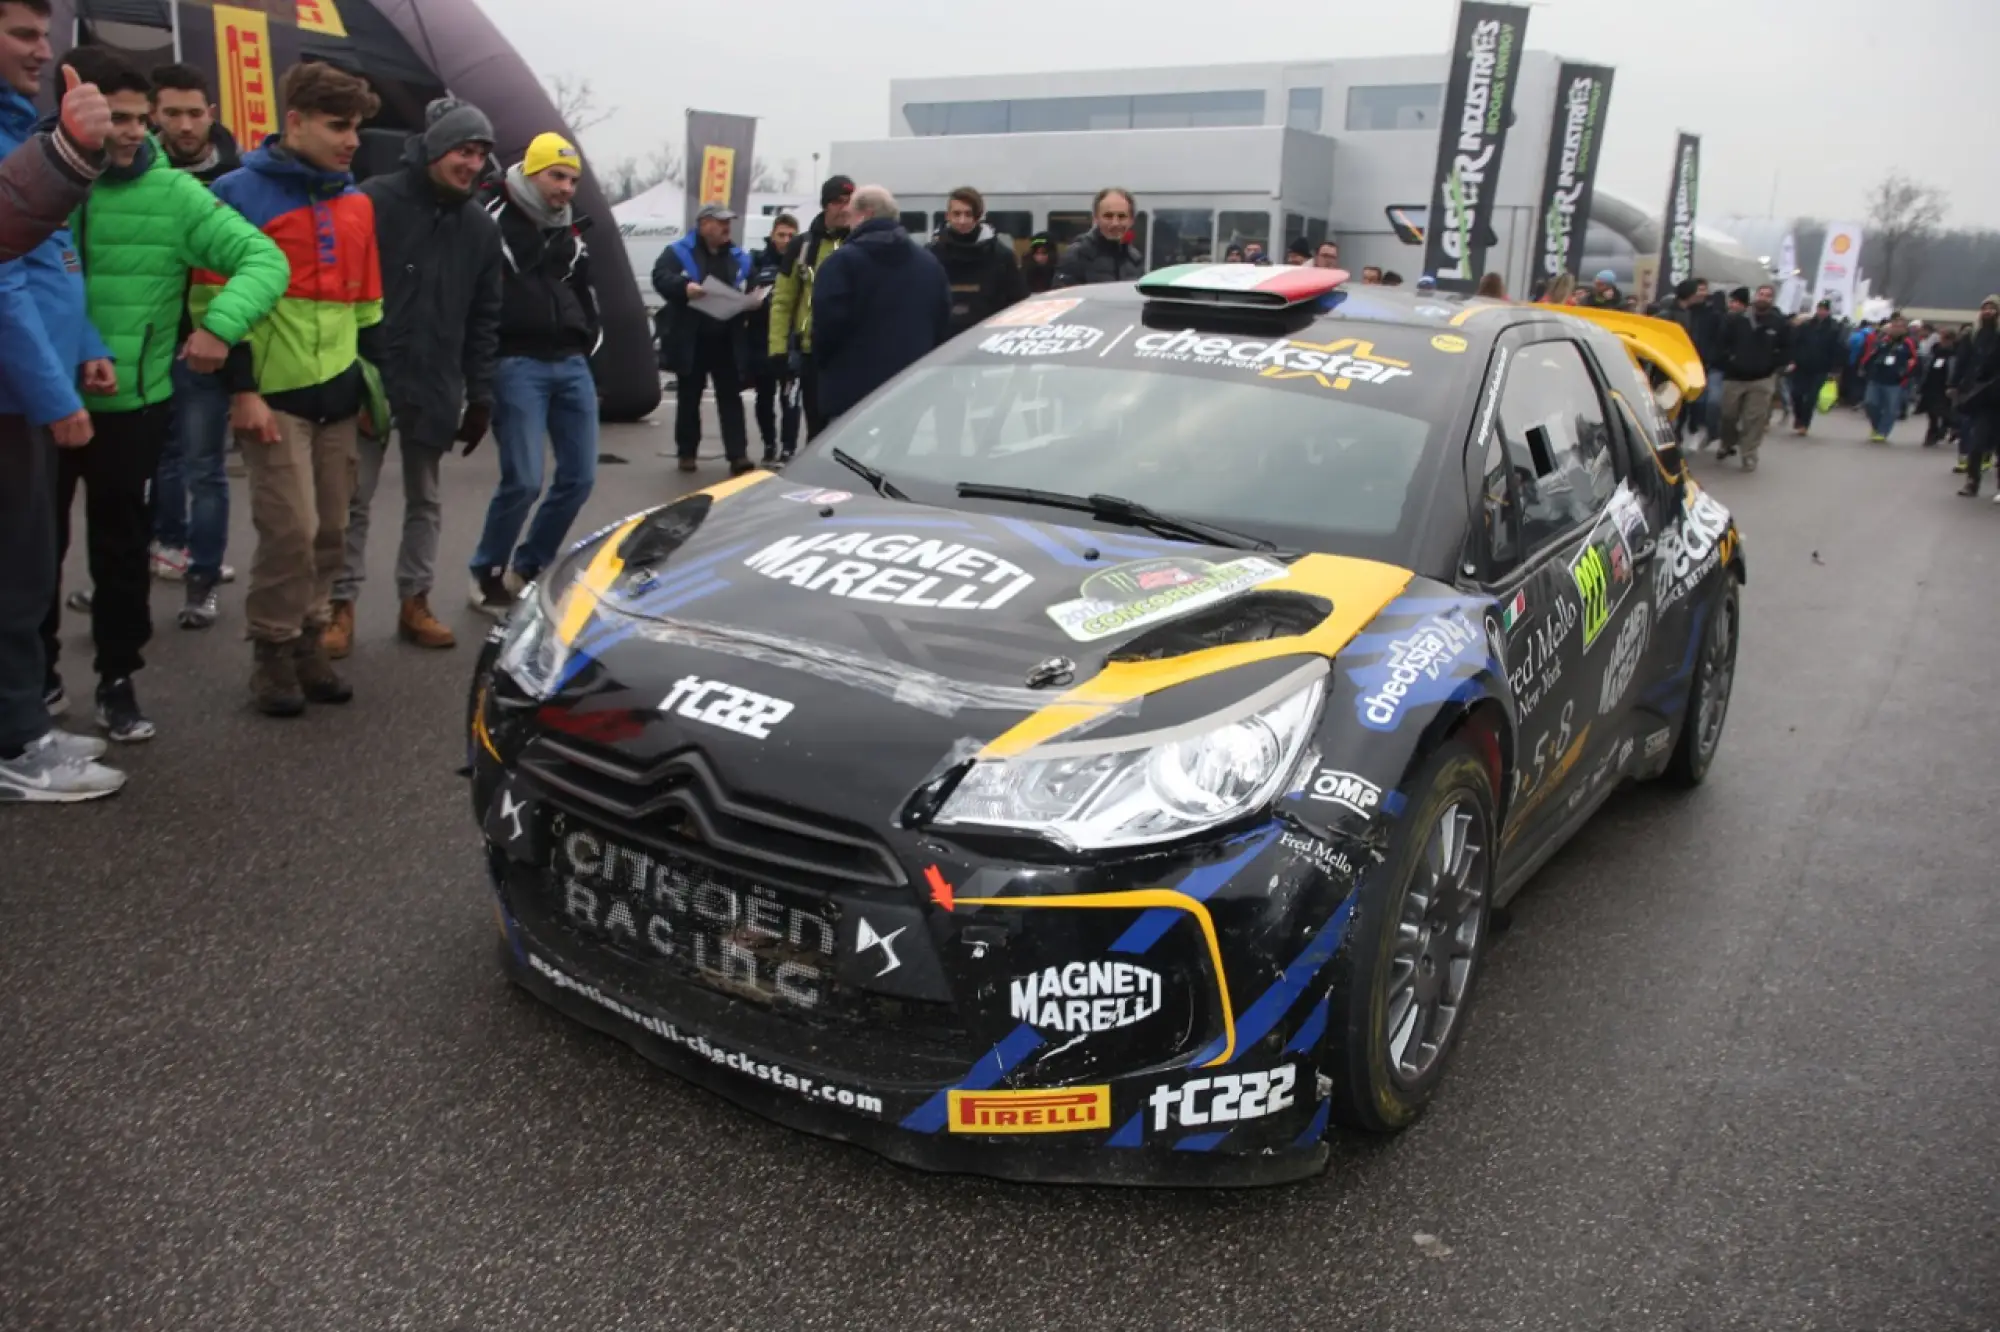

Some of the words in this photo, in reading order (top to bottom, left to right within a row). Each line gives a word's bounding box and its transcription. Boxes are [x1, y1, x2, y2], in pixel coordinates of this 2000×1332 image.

[1458, 19, 1501, 151] INDUSTRIES
[1545, 180, 1585, 276] ASER
[1135, 328, 1413, 385] checkstar
[743, 532, 1036, 590] MAGNETI
[743, 550, 1036, 610] MARELLI
[1363, 633, 1446, 724] checksta
[1314, 774, 1379, 808] OMP
[1279, 831, 1315, 852] Fred
[1314, 841, 1353, 874] Mello
[565, 831, 834, 956] CITROËN
[1010, 961, 1162, 1002] MAGNETI
[1010, 990, 1162, 1032] MARELLI
[959, 1092, 1099, 1126] PIRELLI
